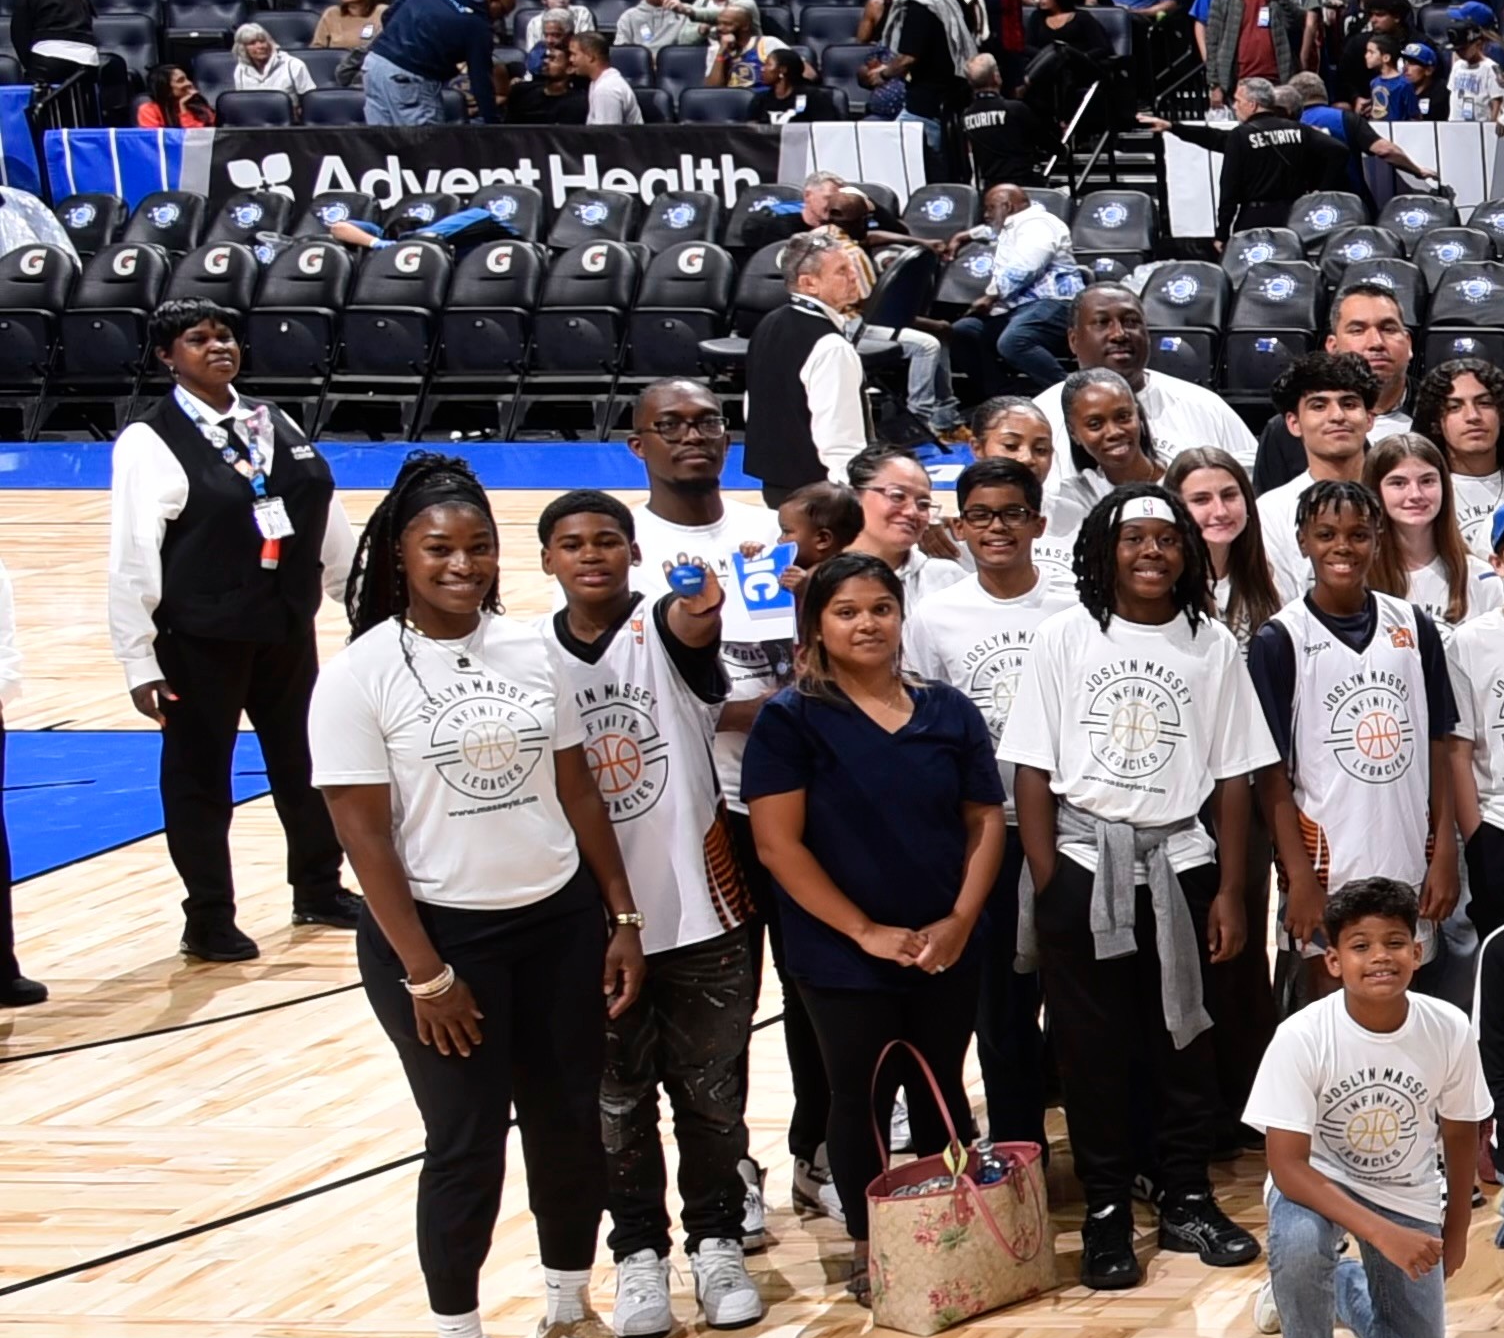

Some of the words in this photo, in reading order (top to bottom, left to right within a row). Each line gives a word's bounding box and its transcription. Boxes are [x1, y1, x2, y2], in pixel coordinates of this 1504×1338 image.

[965, 111, 1006, 131] ECURITY
[313, 154, 540, 209] Advent
[550, 154, 760, 209] Health
[20, 249, 46, 275] G
[113, 249, 138, 275] G
[204, 248, 230, 274] G
[299, 247, 325, 273] G
[395, 246, 422, 272] G
[487, 247, 512, 272] G
[582, 245, 608, 272] G
[678, 247, 705, 273] G
[1086, 660, 1136, 693] JOSLYN
[1144, 661, 1192, 704] MASSEY
[1325, 671, 1365, 712] JOSLYN
[418, 681, 467, 724] JOSLYN
[472, 680, 539, 708] MASSEY
[1105, 684, 1166, 712] INFINITE
[1346, 696, 1399, 720] INFINITE
[446, 705, 516, 730] INFINITE
[1100, 744, 1158, 772] LEGACIES
[1352, 752, 1405, 779] LEGACIES
[460, 763, 523, 791] LEGACIES
[1343, 1092, 1403, 1115] INFINITE
[1339, 1148, 1401, 1167] LEGACIES
